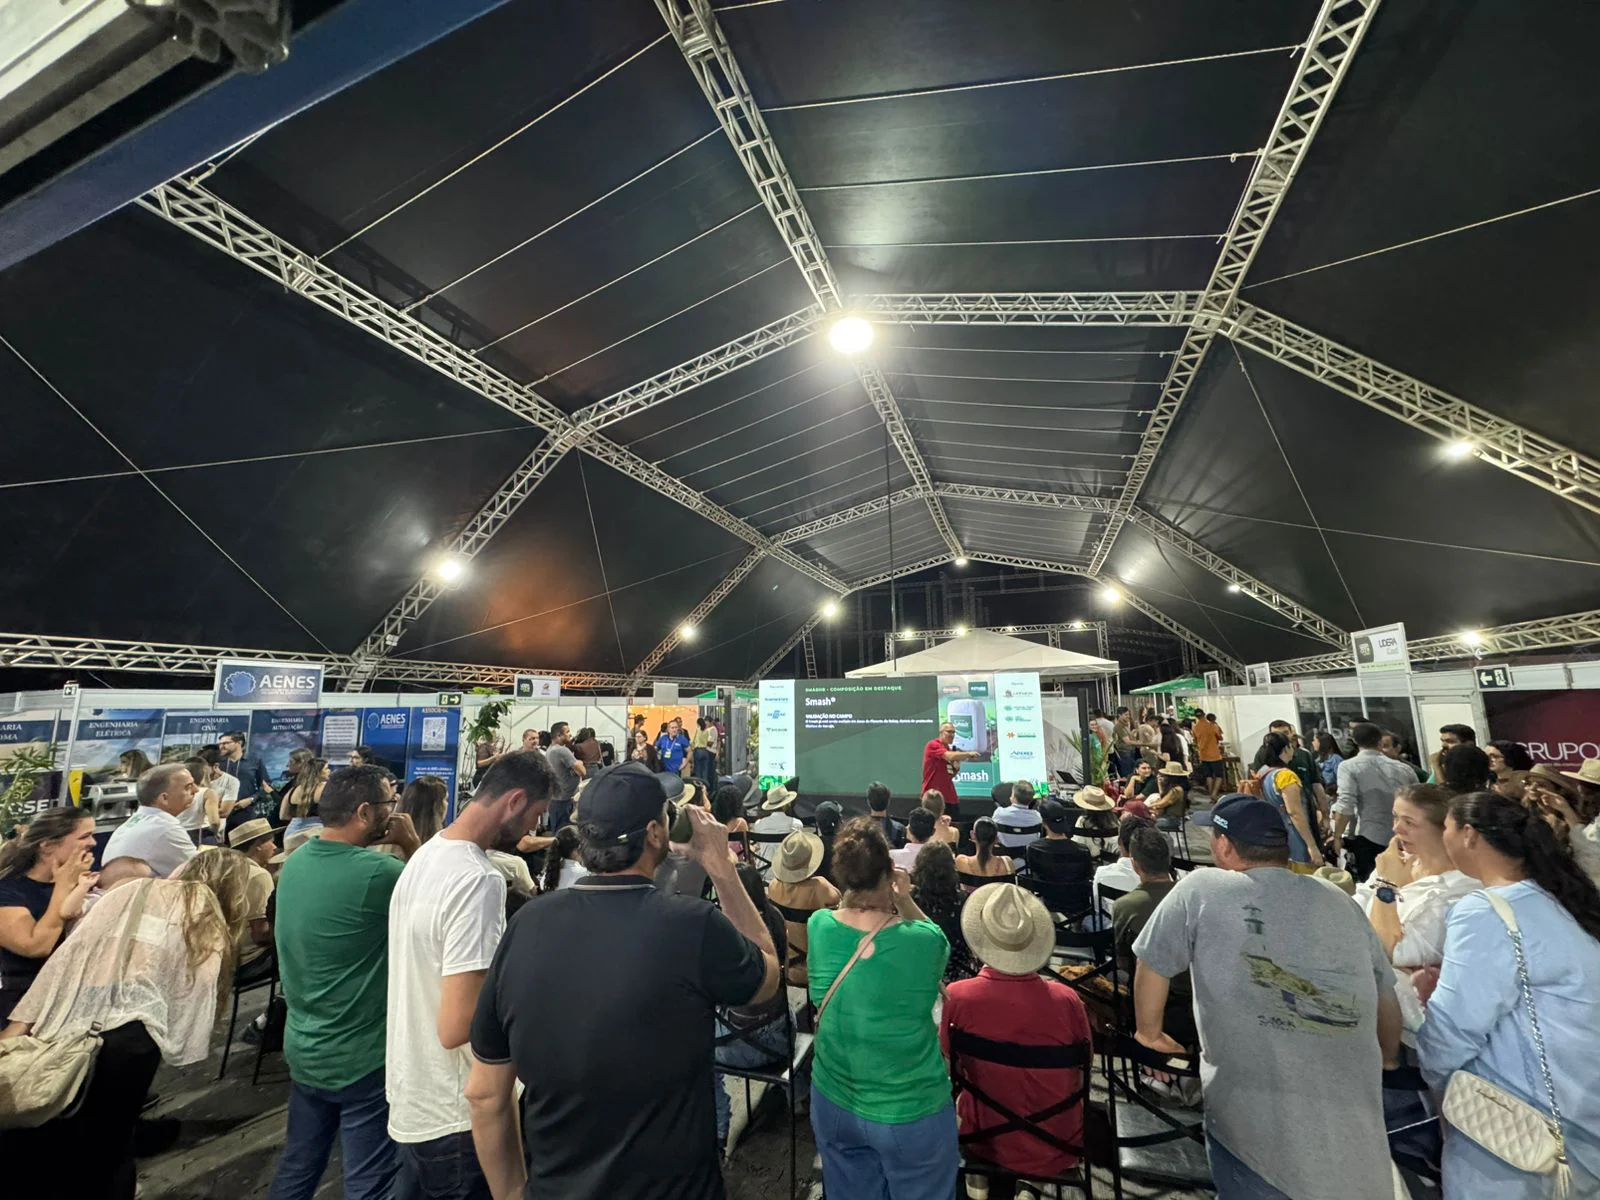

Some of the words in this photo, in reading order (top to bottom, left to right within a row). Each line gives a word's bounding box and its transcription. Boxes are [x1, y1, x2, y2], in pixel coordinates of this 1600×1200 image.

[259, 674, 316, 689] AENES
[190, 716, 229, 724] ENGENHARIA
[380, 713, 406, 724] AENES
[95, 729, 132, 737] ELÉTRICA
